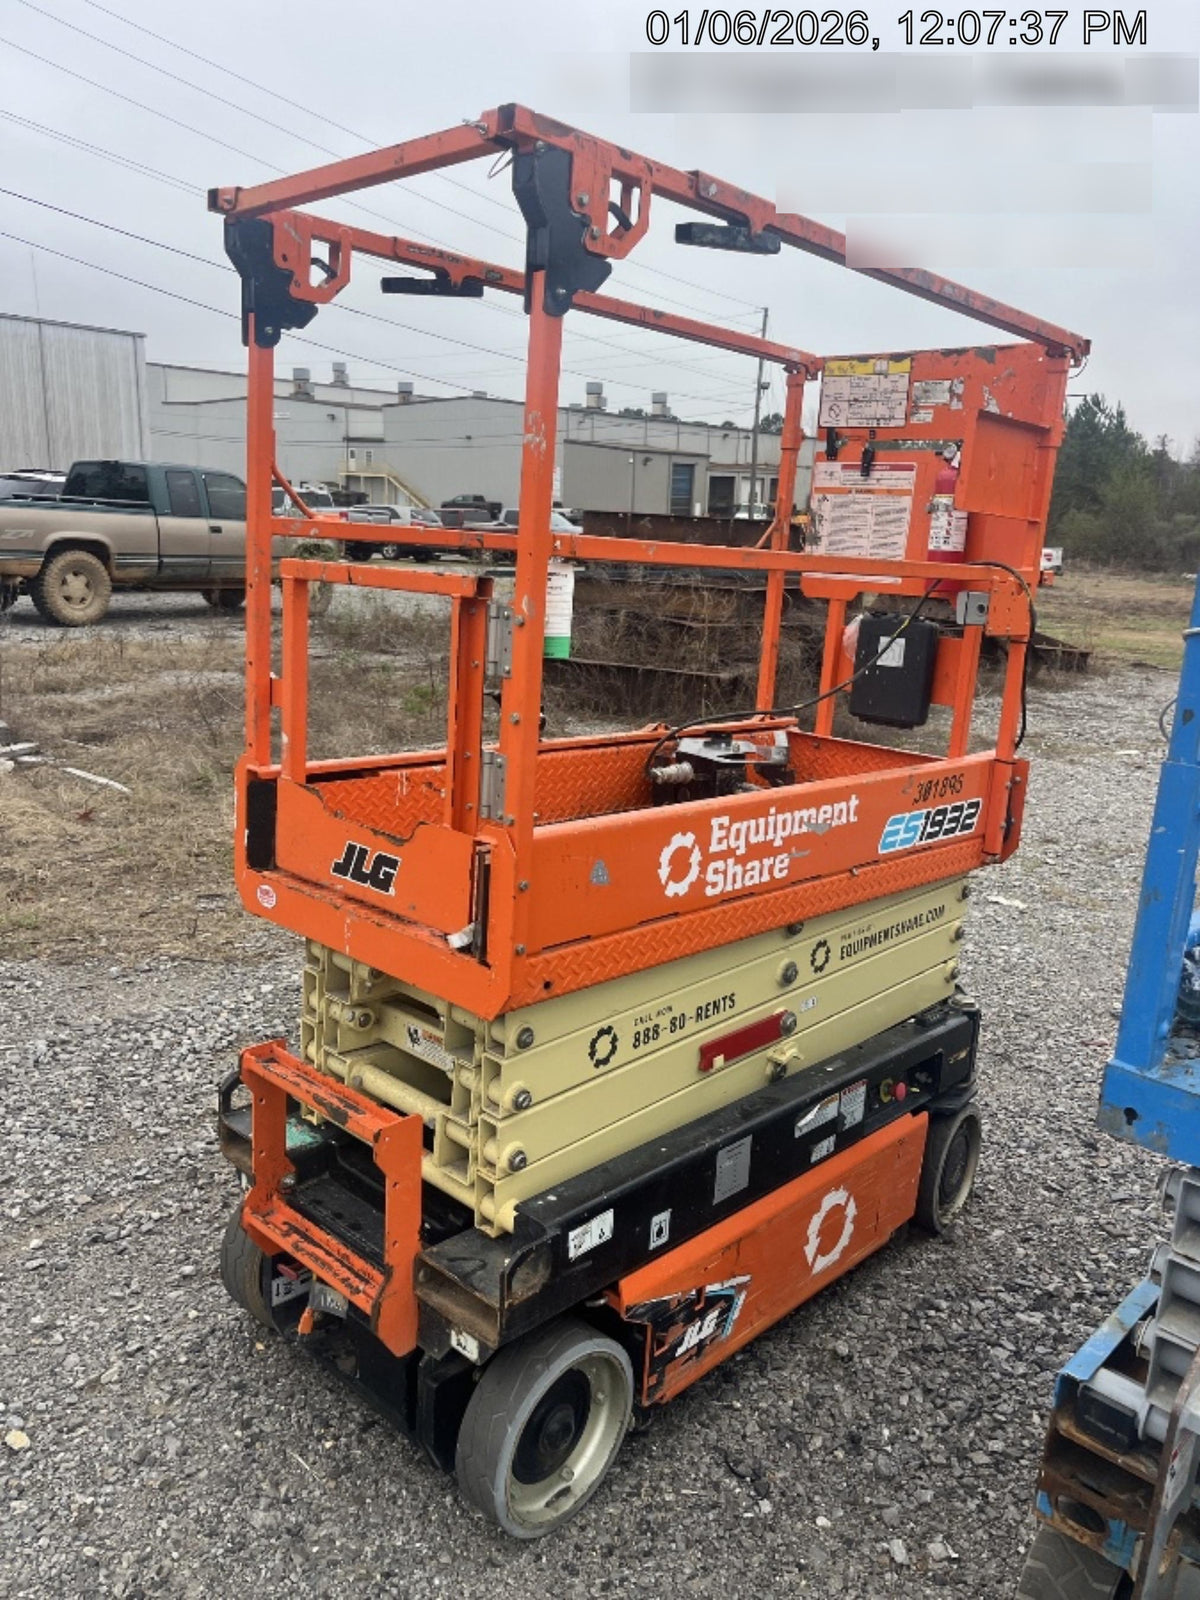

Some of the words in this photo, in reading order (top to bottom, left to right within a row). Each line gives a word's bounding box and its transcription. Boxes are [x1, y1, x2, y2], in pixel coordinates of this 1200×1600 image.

[709, 794, 860, 855] Equipment
[878, 798, 983, 854] ES1932
[330, 840, 402, 896] JLG
[704, 854, 790, 897] Share
[840, 903, 946, 961] EQUIPMENTSHARE.COM
[632, 992, 737, 1050] 888-80-RENTS
[675, 1307, 721, 1357] JLG
